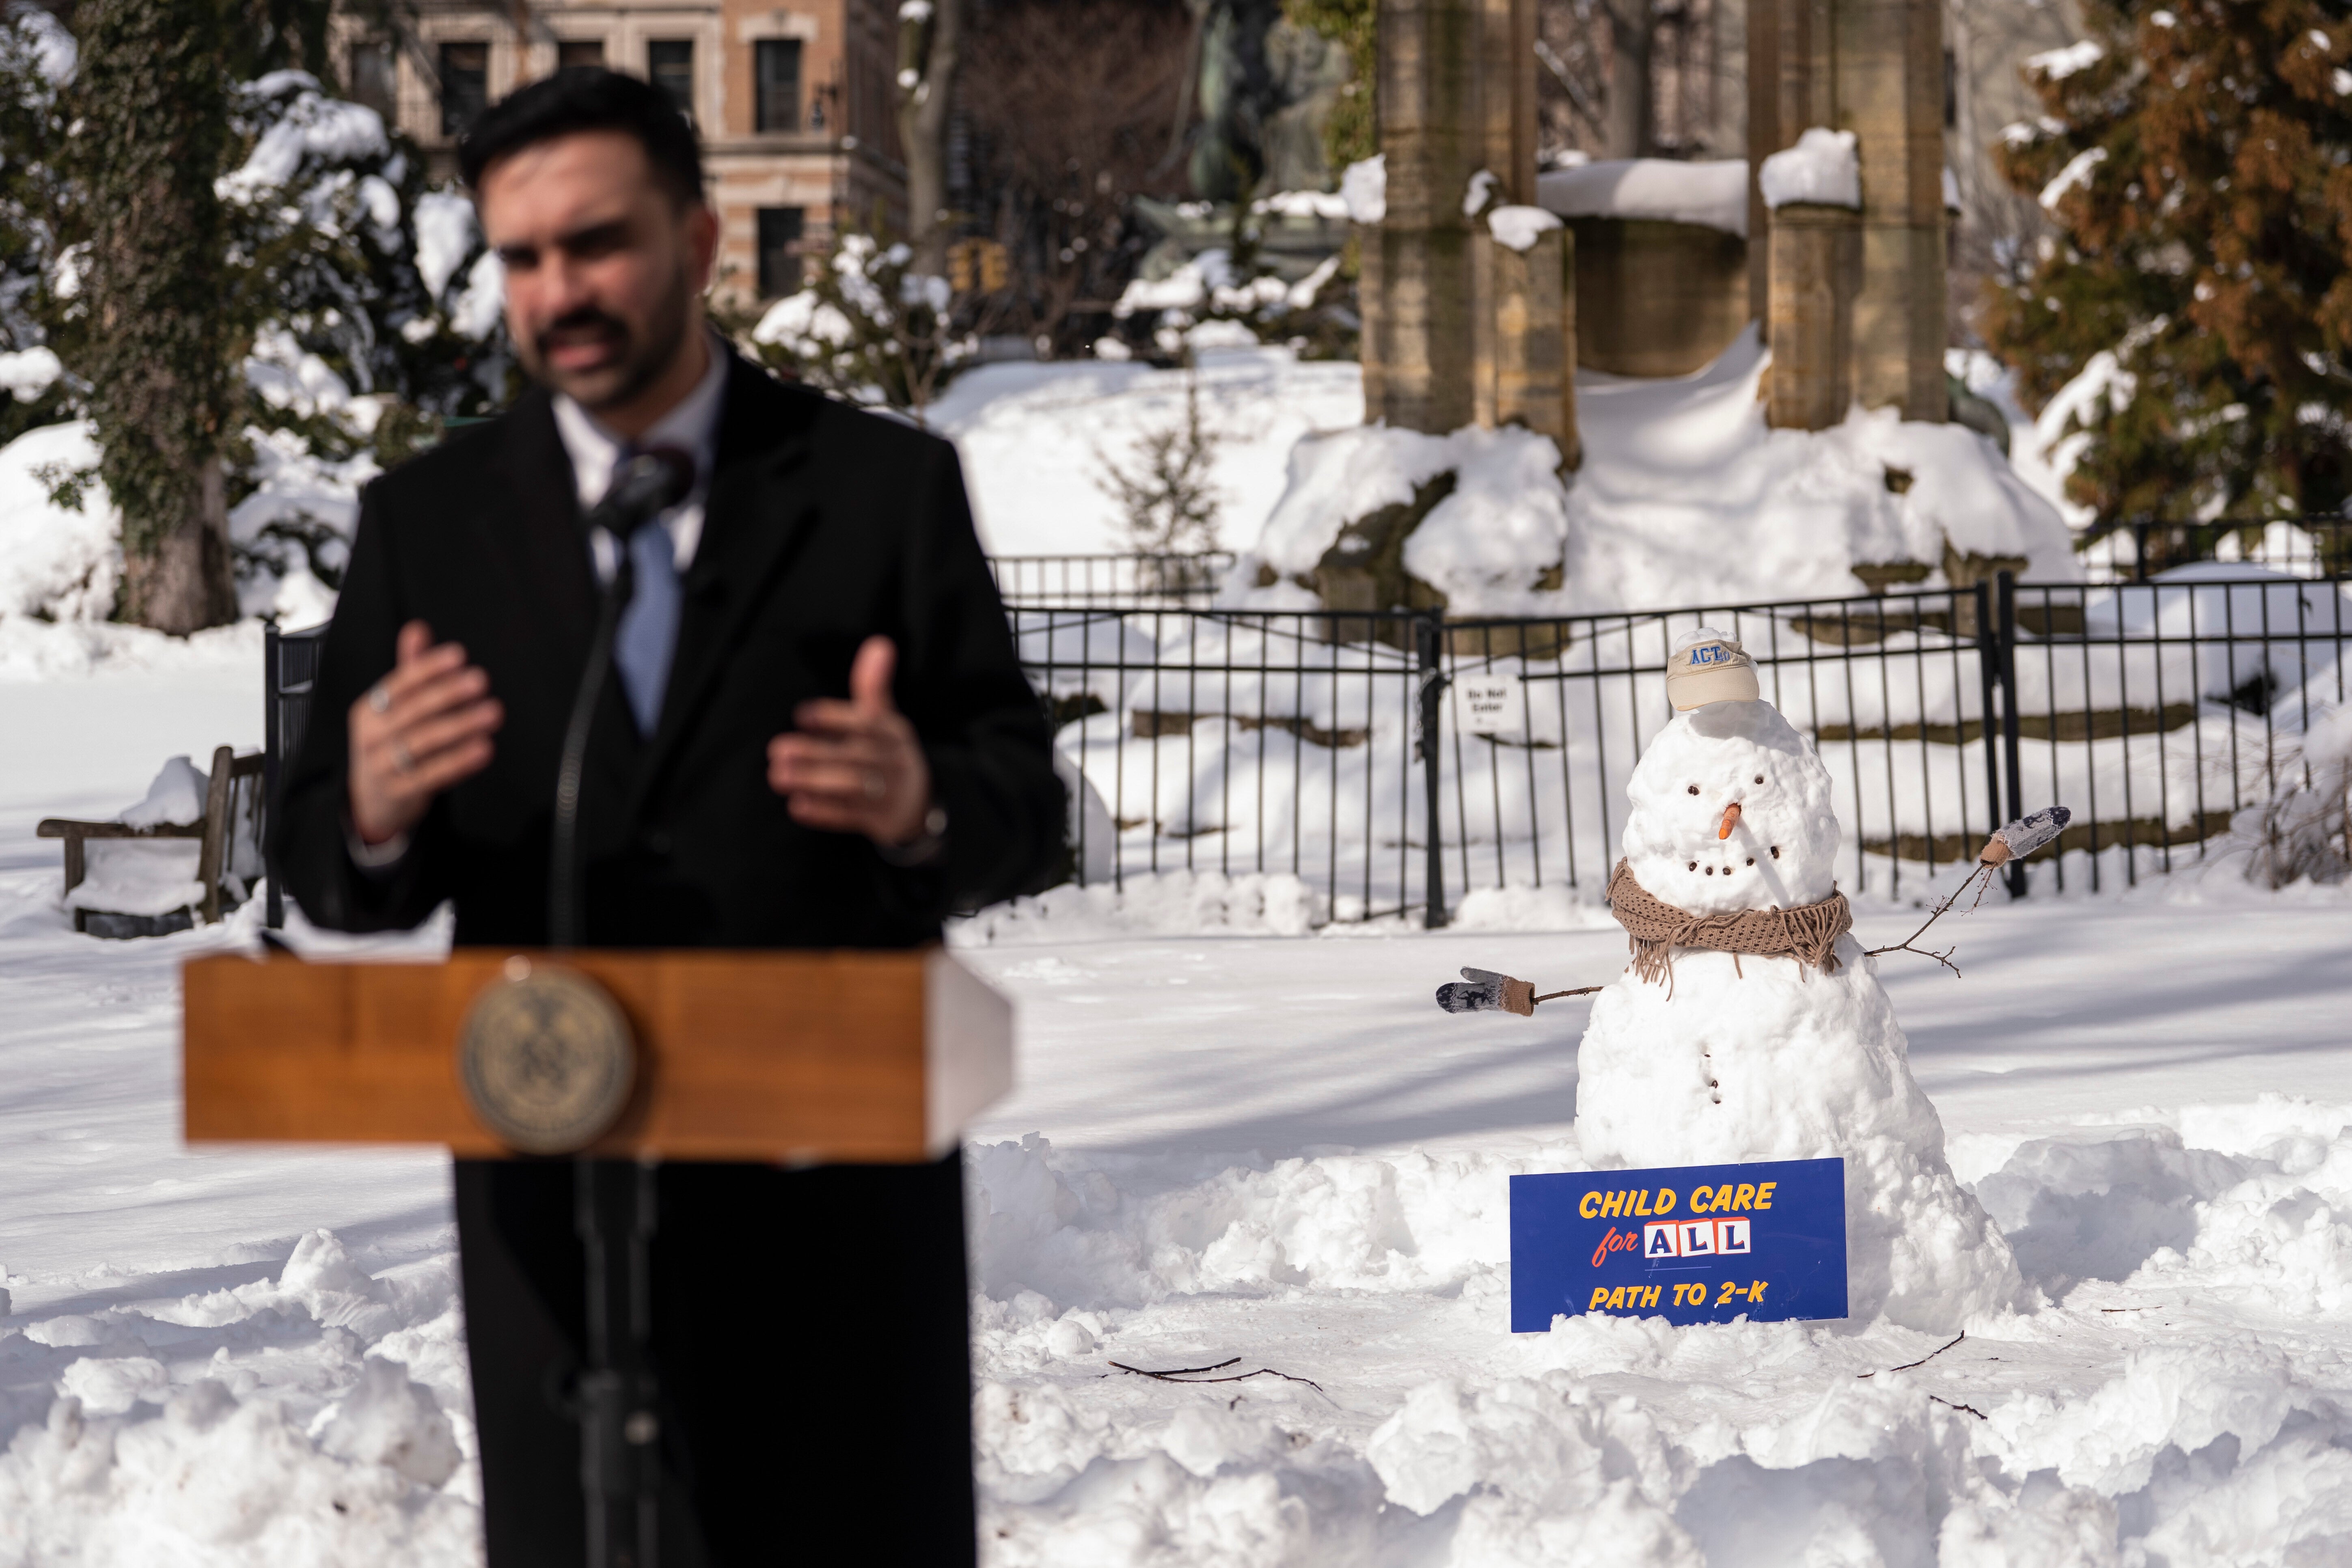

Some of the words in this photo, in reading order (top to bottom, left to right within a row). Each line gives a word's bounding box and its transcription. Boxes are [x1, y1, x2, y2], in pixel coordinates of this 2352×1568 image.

[1579, 1188, 1677, 1219] CHILD
[1690, 1182, 1777, 1213] CARE
[1592, 1227, 1638, 1267] for
[1649, 1224, 1746, 1255] ALL
[1589, 1285, 1662, 1310] PATH
[1673, 1283, 1707, 1306] TO
[1718, 1280, 1768, 1304] 2-K
